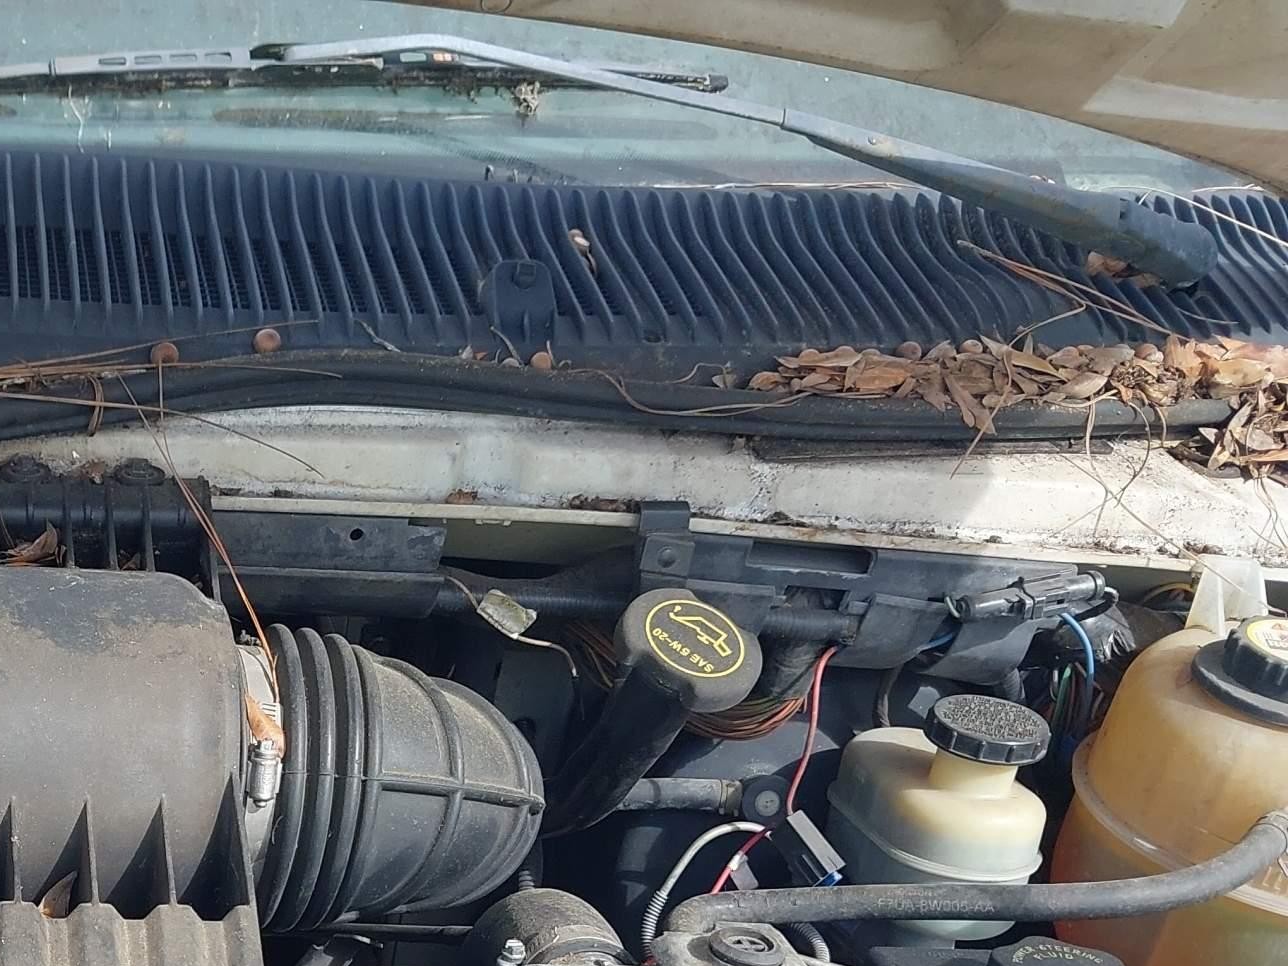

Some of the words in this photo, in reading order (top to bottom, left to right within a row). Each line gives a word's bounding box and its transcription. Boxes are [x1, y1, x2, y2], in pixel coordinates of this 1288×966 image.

[689, 652, 715, 673] SAE
[1012, 945, 1034, 964] POWER
[1038, 944, 1104, 964] STEERING
[1033, 952, 1075, 961] FLUID
